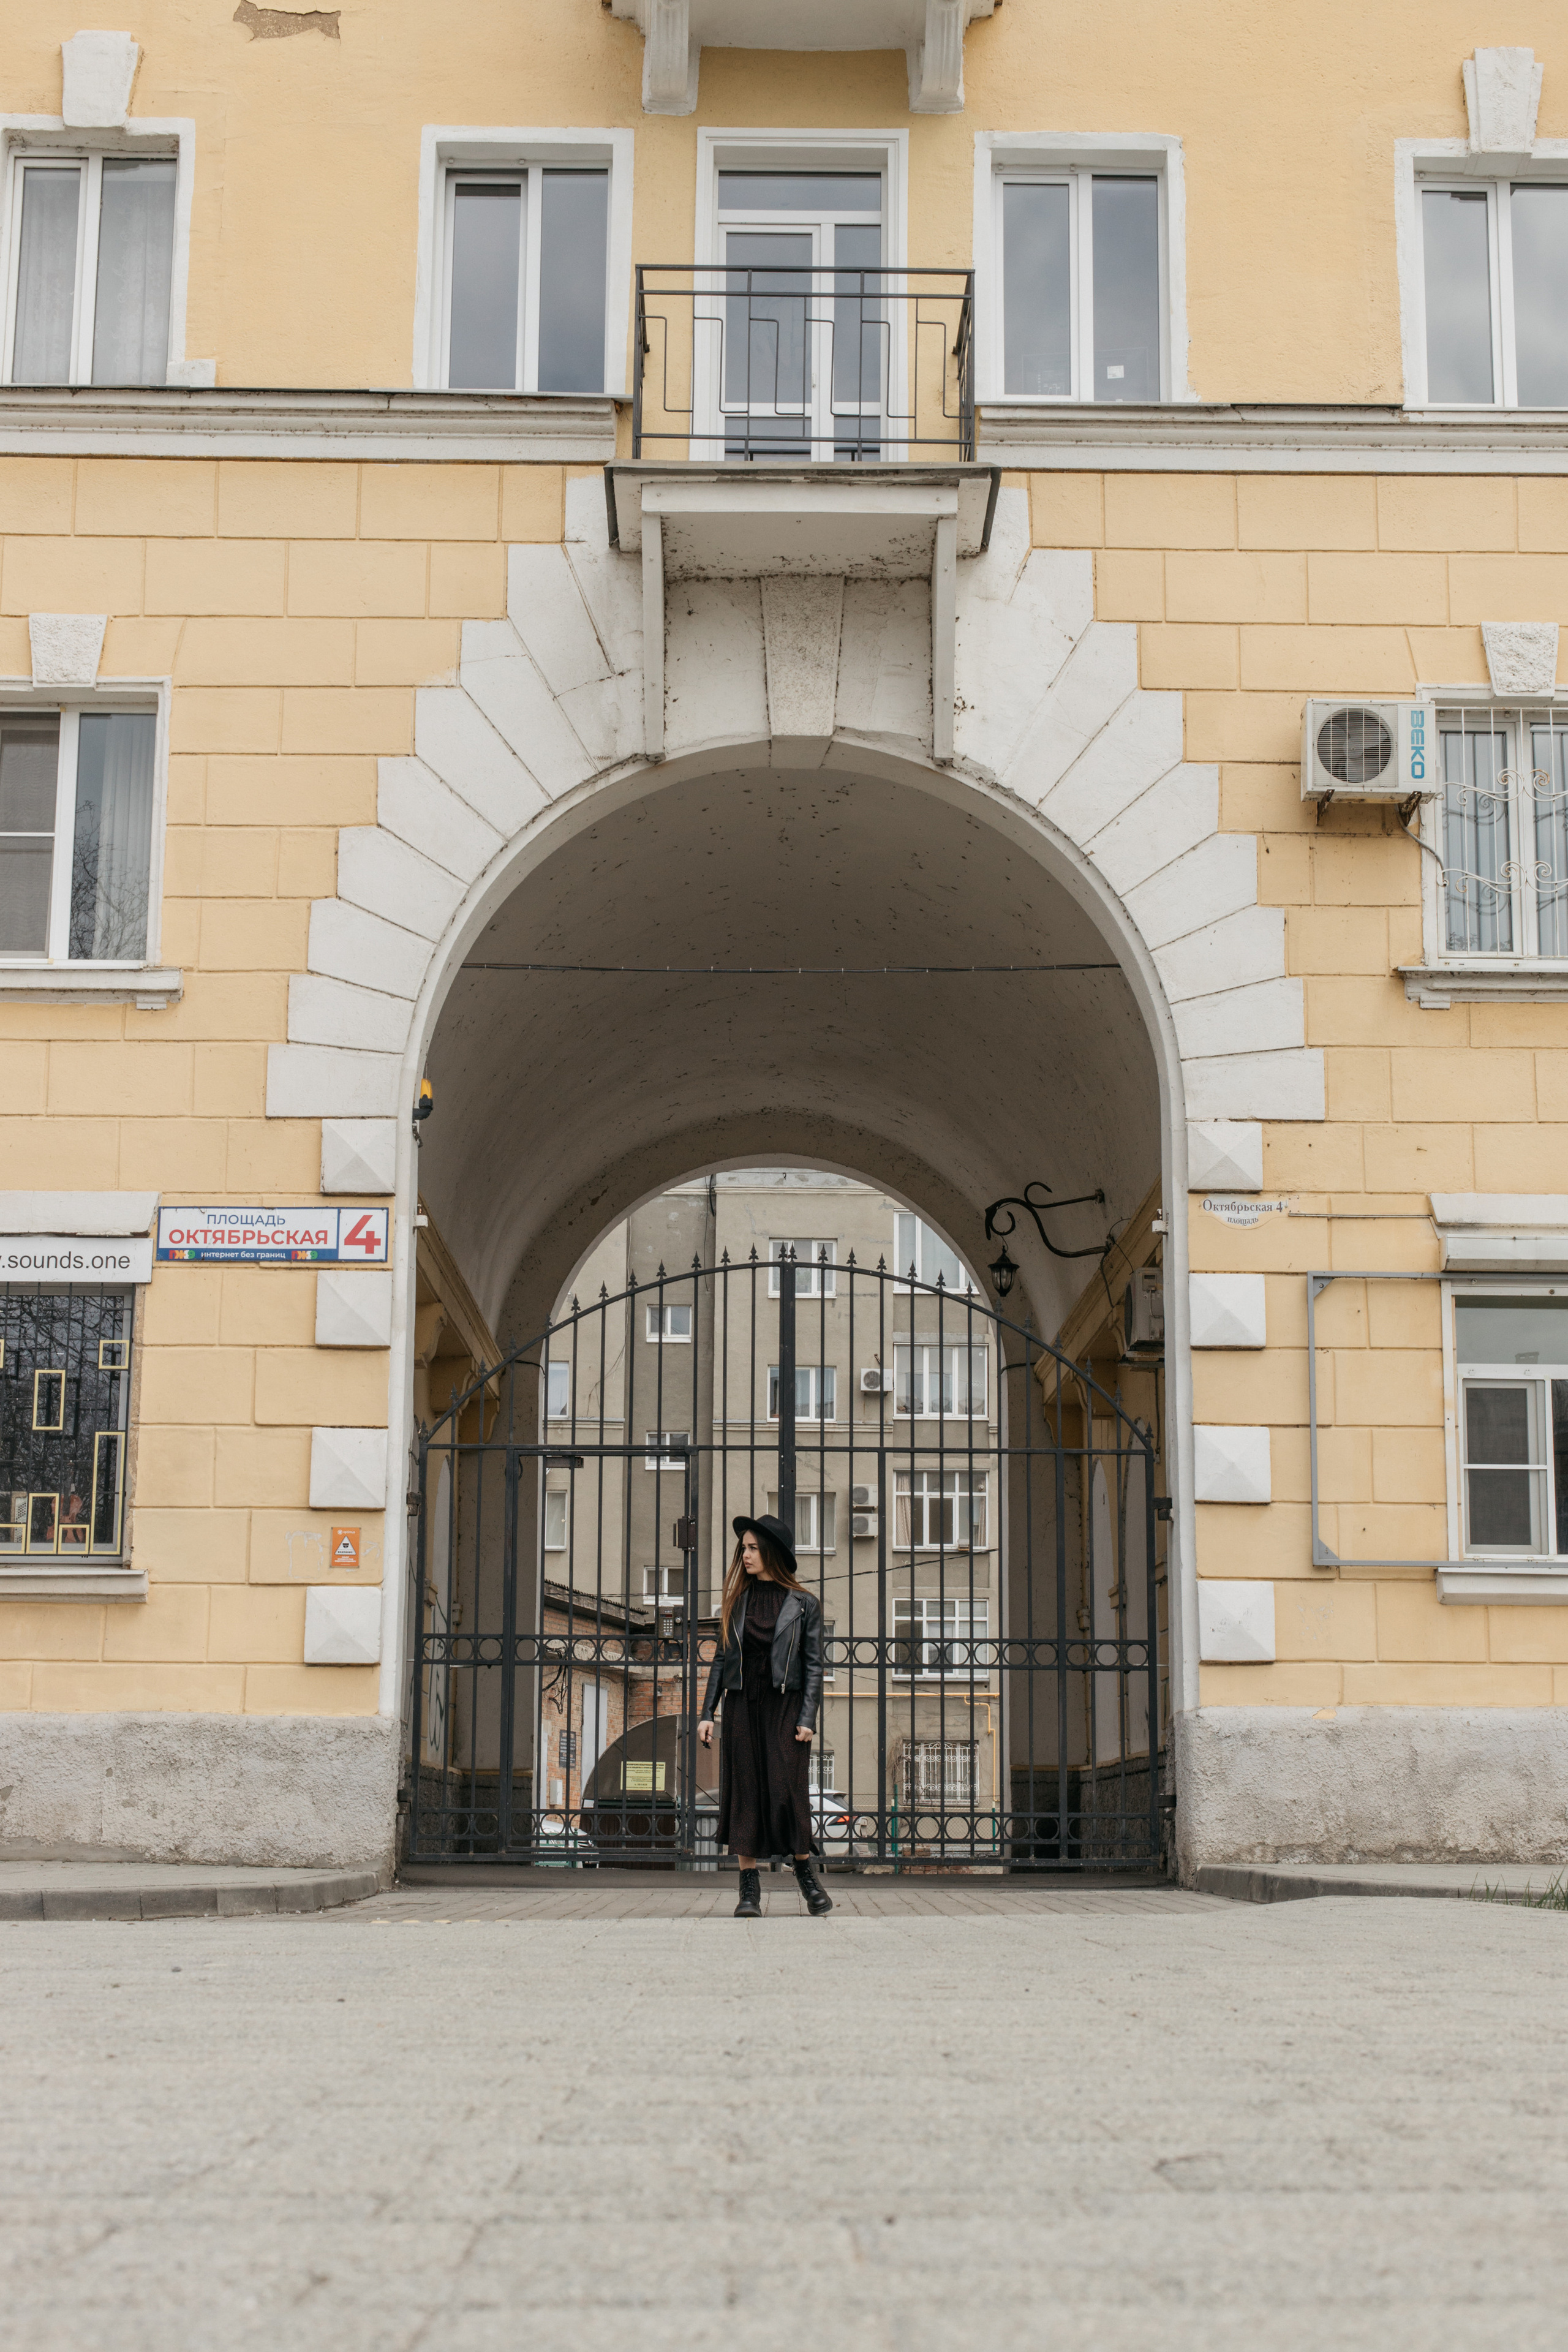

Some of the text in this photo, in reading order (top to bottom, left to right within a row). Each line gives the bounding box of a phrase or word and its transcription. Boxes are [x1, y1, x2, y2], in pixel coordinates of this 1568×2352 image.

[1411, 710, 1425, 779] BEKO
[1202, 1199, 1283, 1214] Октябрьская 4
[207, 1214, 286, 1227] ПЛОЩАДЬ
[1227, 1216, 1259, 1225] площадь
[168, 1229, 328, 1245] ОКТЯБРЬСКАЯ
[344, 1215, 381, 1254] 4
[0, 1251, 130, 1269] .sounds.one
